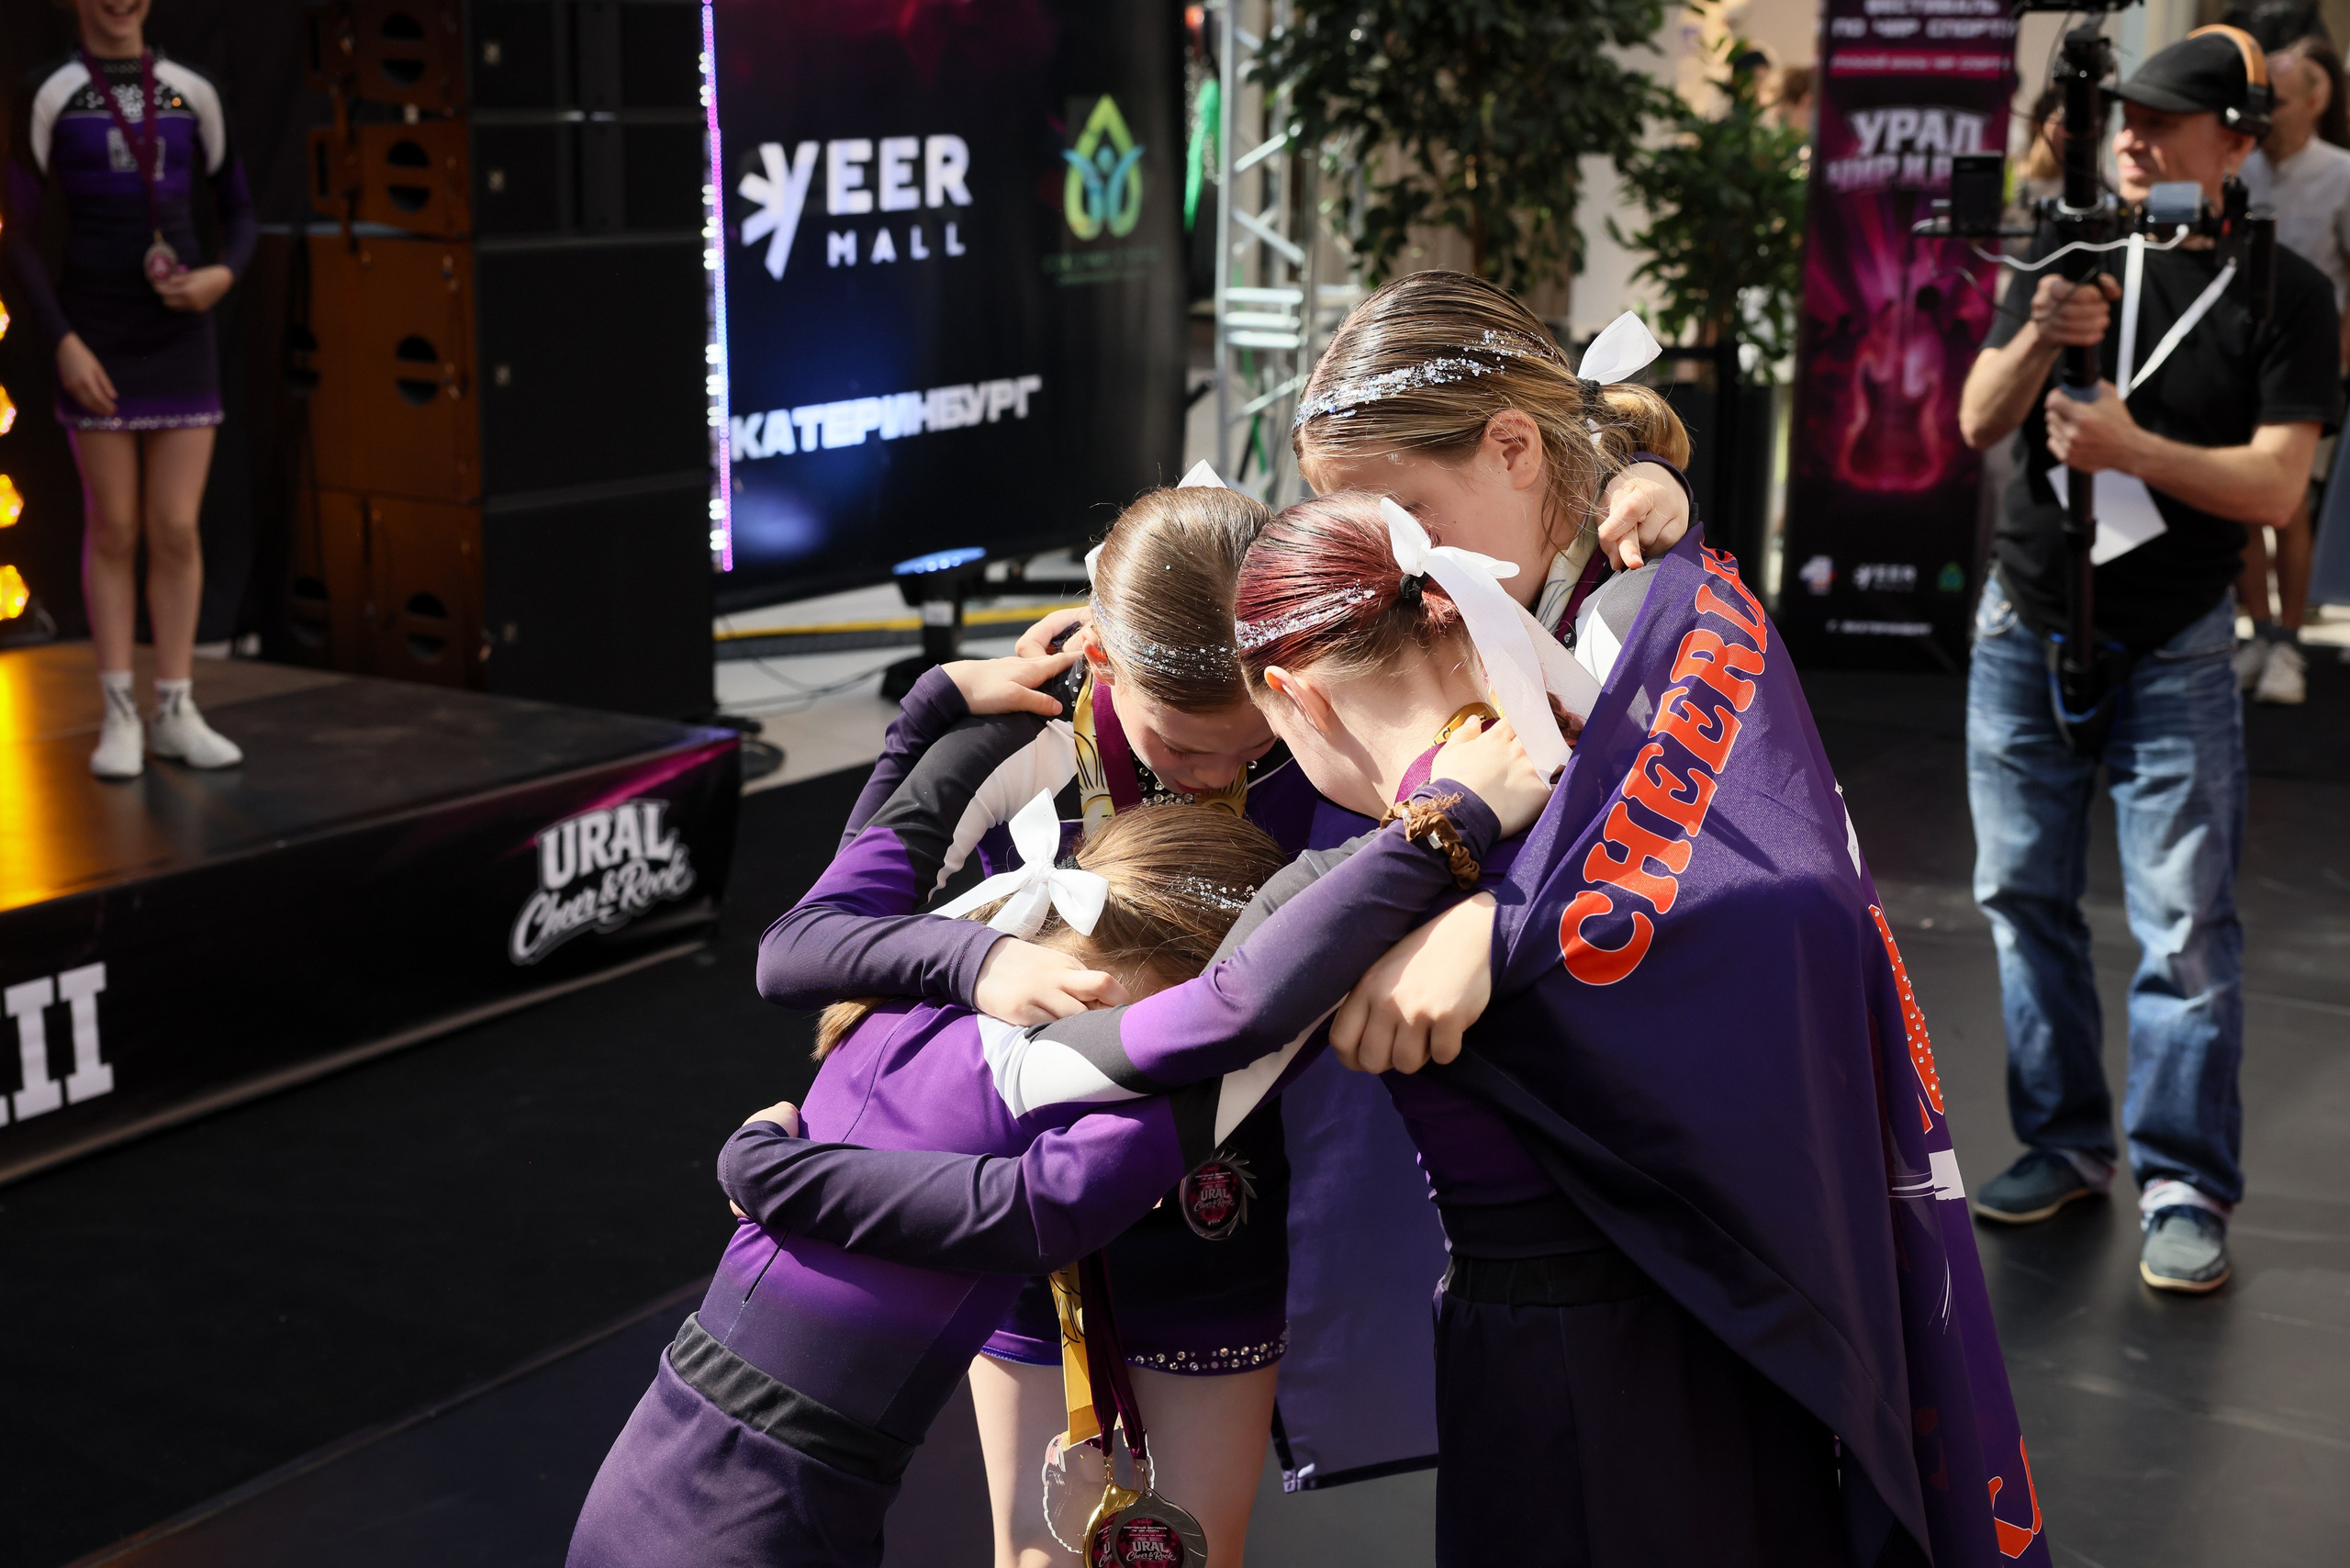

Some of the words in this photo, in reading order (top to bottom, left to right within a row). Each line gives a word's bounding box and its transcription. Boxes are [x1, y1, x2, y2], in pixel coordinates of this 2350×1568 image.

[1849, 107, 1986, 157] УРАЛ
[827, 222, 966, 268] MALL
[541, 801, 675, 890] URAL
[1201, 1188, 1230, 1201] URAL
[1126, 1550, 1147, 1562] Cheer
[1153, 1551, 1177, 1562] Rock
[1132, 1540, 1169, 1553] URAL
